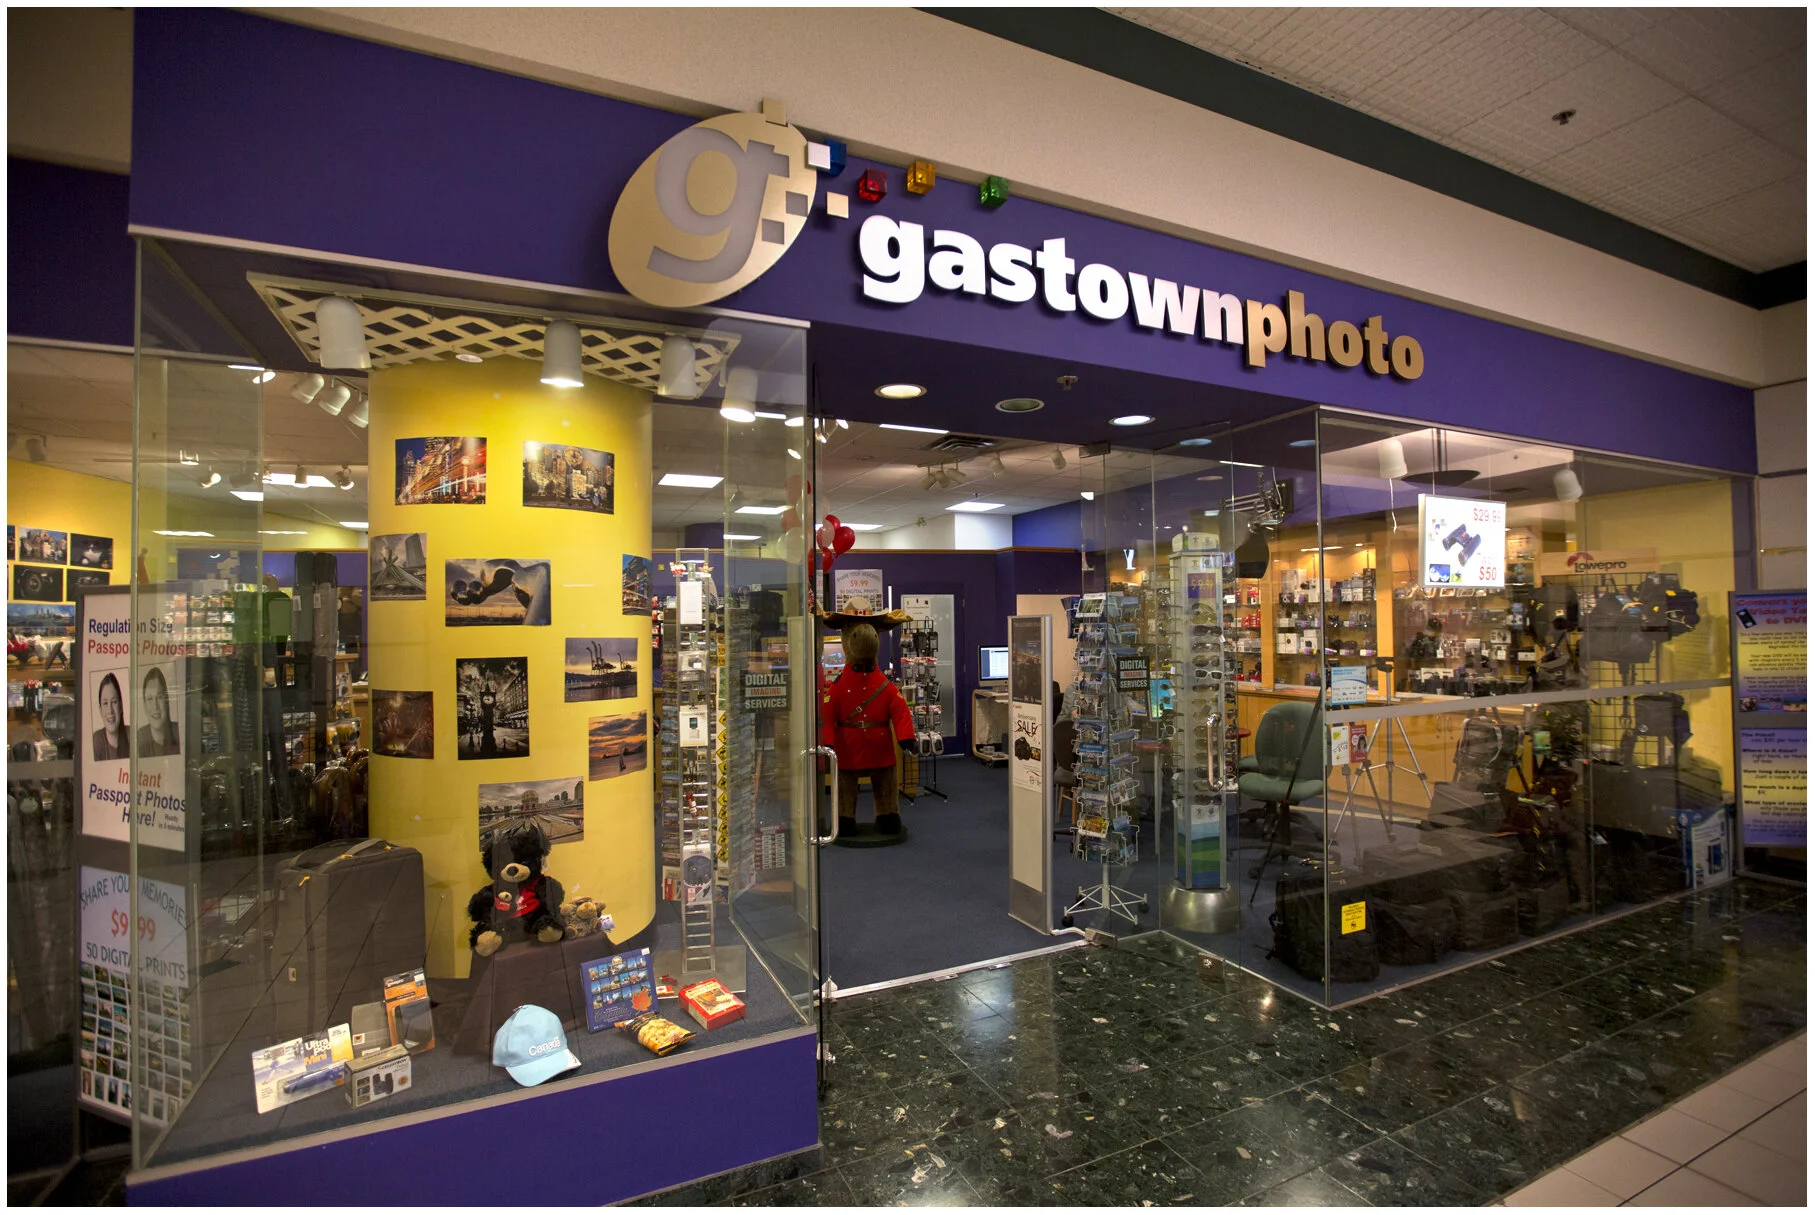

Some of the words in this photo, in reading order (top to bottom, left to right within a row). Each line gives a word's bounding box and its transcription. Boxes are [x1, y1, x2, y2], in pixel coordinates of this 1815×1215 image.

[1479, 566, 1498, 581] $50
[1575, 561, 1627, 572] Lowepro
[89, 618, 147, 637] Regulatin
[142, 640, 185, 656] Photos
[1120, 660, 1147, 670] DIGITAL
[745, 673, 787, 686] DIGITAL
[1120, 679, 1148, 689] SERVICES
[750, 687, 782, 696] IMAGING
[745, 698, 787, 709] SERVICES
[1017, 719, 1038, 736] SALE
[118, 767, 162, 788] Intant
[89, 783, 142, 807] Passpot
[145, 790, 185, 812] Photos
[122, 807, 156, 827] Hre!
[80, 878, 109, 911] SHARE
[111, 875, 131, 894] YOU
[142, 880, 186, 929] MEMORIE
[111, 908, 156, 942] $999
[86, 942, 98, 960] 50
[101, 945, 142, 972] DIGIT
[145, 956, 186, 981] PRINTS
[304, 1038, 328, 1051] Ultra
[528, 1036, 561, 1057] Canada
[303, 1051, 328, 1066] Mini
